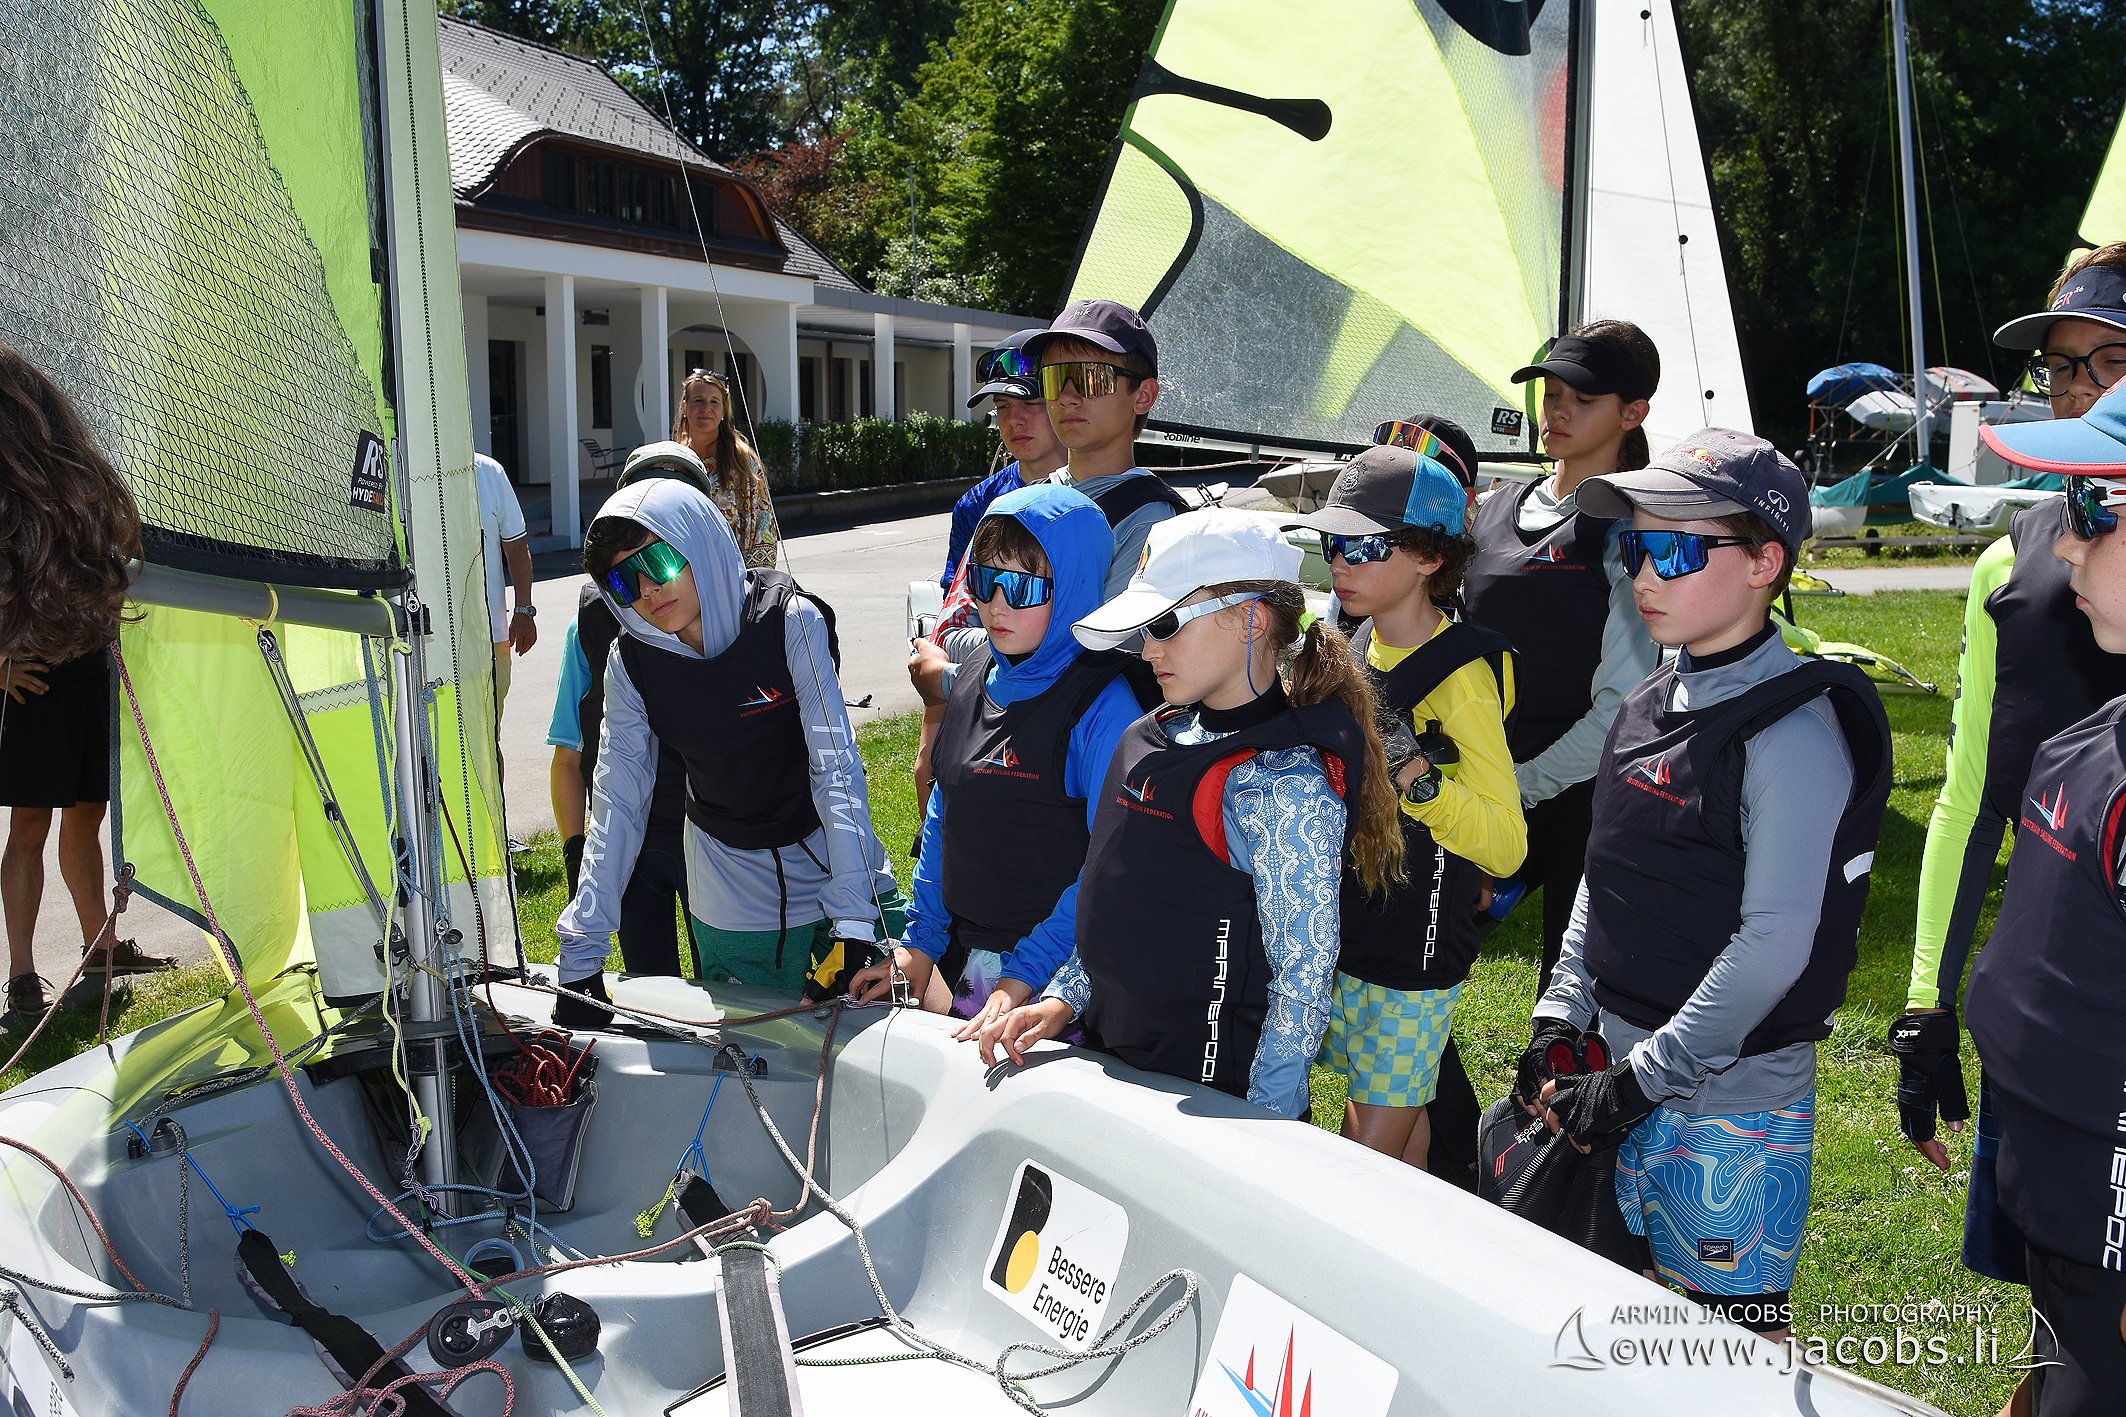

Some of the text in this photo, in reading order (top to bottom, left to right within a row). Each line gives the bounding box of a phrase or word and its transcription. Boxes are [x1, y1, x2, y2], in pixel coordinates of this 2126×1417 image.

[1497, 411, 1520, 425] RS
[1753, 496, 1790, 532] INFINITI
[1143, 807, 1175, 821] FEDERATION
[1422, 845, 1445, 971] ARINEPOOL
[1703, 1243, 1729, 1252] speedo
[1047, 1245, 1106, 1305] Bessere
[1032, 1282, 1089, 1342] Energie
